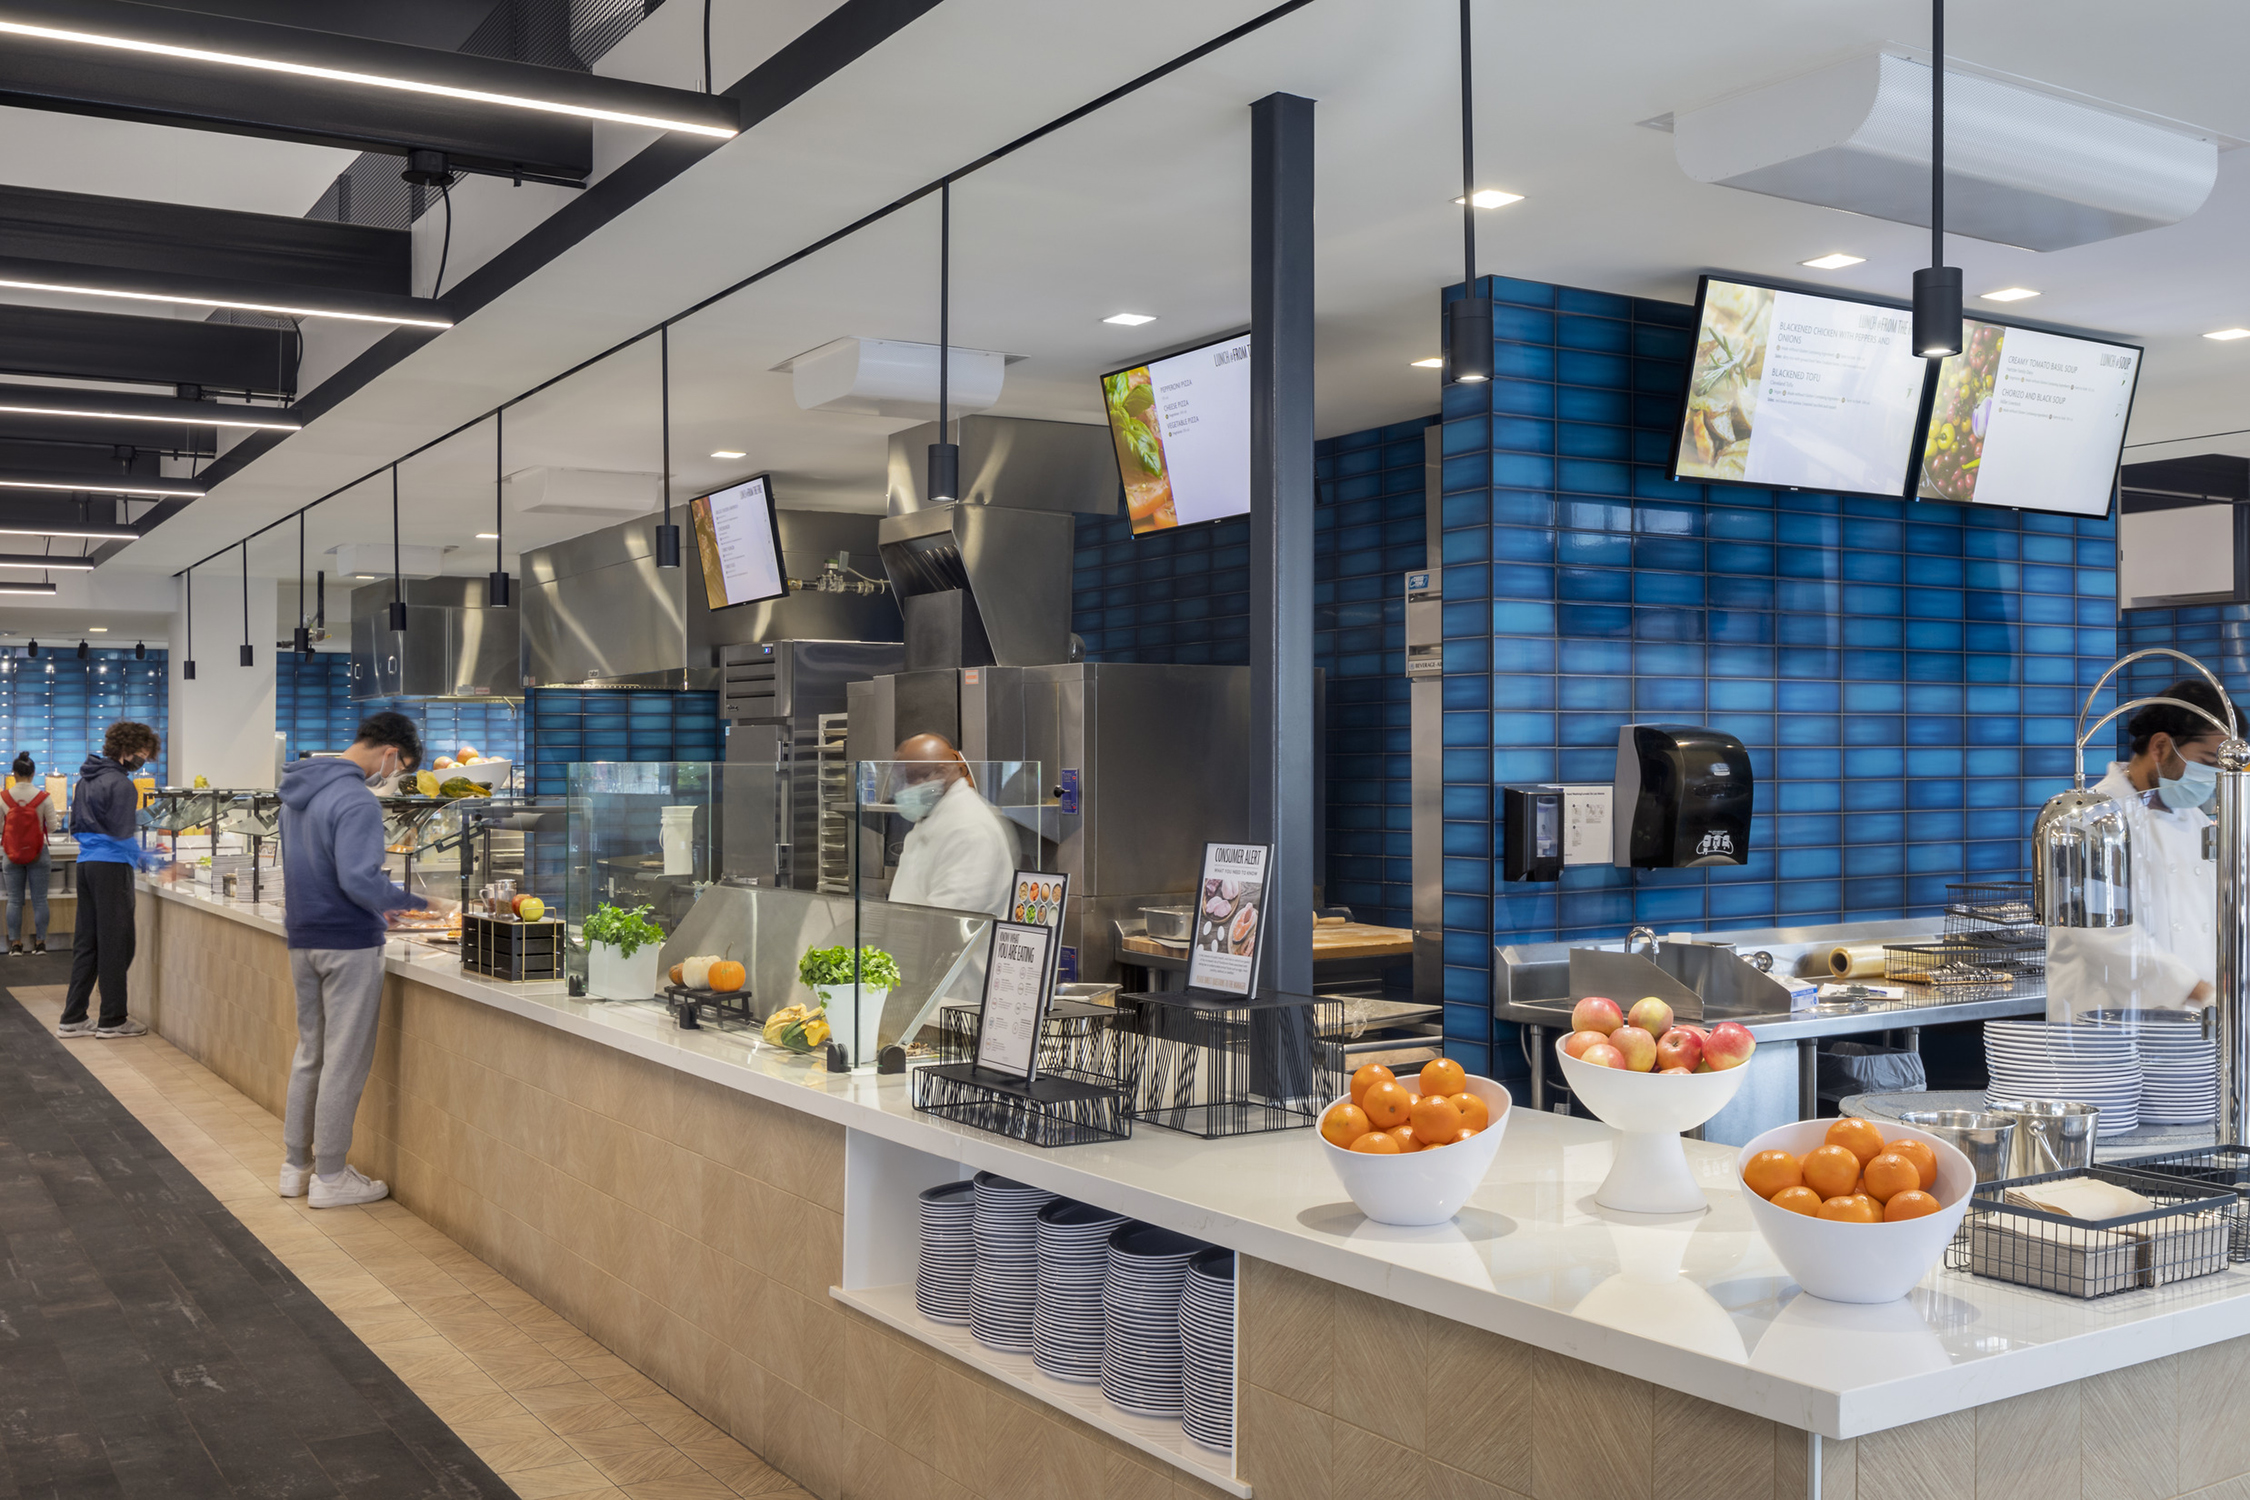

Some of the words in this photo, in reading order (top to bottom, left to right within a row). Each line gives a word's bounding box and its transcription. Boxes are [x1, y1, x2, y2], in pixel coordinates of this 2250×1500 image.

[1859, 314, 1877, 331] LUNCH
[1777, 333, 1802, 345] ONIONS
[1780, 321, 1812, 334] BLACKENED
[1813, 326, 1837, 338] CHICKEN
[1839, 330, 1854, 339] WITH
[1855, 333, 1877, 344] PEPPERS
[1878, 337, 1890, 346] AND
[1213, 350, 1230, 367] LUNCH
[2008, 355, 2029, 366] CREAMY
[2029, 359, 2050, 370] TOMATO
[2051, 362, 2064, 372] BASIL
[2064, 364, 2078, 374] SOUP
[2100, 352, 2116, 368] LUNCH
[1771, 369, 1805, 380] BLACKENED
[1806, 372, 1821, 382] TOFU
[1160, 382, 1180, 393] PEPPERONI
[1181, 379, 1192, 388] PIZZA
[2002, 388, 2025, 399] CHORIZO
[2025, 391, 2036, 401] AND
[2037, 393, 2052, 403] BLACK
[2052, 395, 2066, 405] SOUP
[1163, 402, 1178, 412] CHEESE
[1178, 400, 1189, 408] PIZZA
[1167, 419, 1188, 429] VEGETABLE
[1188, 416, 1199, 424] PIZZA
[1215, 847, 1244, 864] CONSUMER
[1243, 849, 1261, 865] ALERT
[998, 942, 1009, 959] YOU
[1007, 943, 1018, 960] ARE
[1017, 945, 1035, 963] EATING
